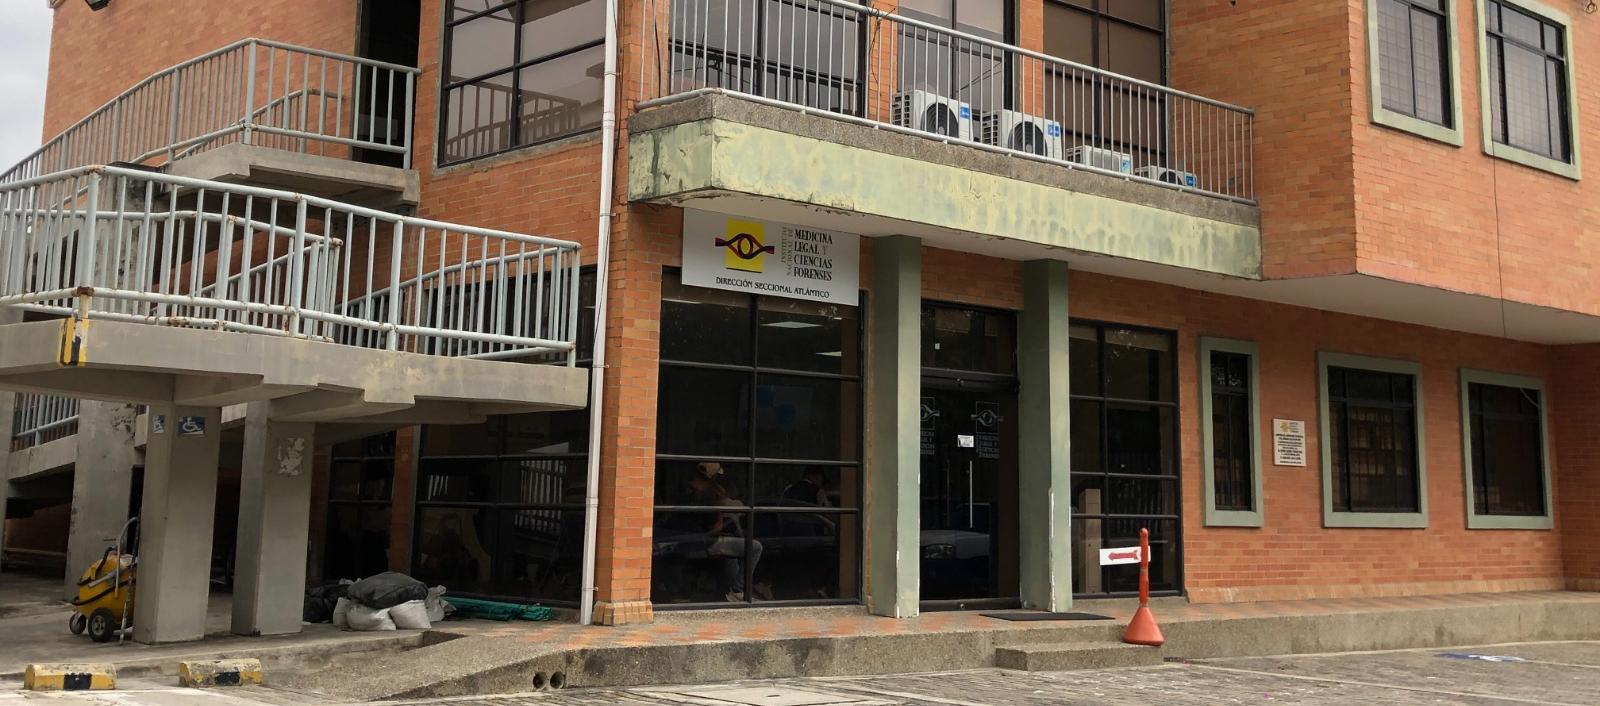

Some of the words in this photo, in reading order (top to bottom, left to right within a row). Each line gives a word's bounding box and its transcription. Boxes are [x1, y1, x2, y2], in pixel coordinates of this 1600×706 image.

[795, 229, 833, 245] MEDICINA
[794, 241, 820, 255] LEGAL
[823, 245, 828, 256] Y
[794, 254, 833, 269] CIENCIAS
[794, 267, 832, 281] FORENSES
[716, 276, 753, 289] DIRECCIÓN
[755, 282, 792, 294] SECCIONAL
[794, 287, 830, 299] ATLÁNTICO
